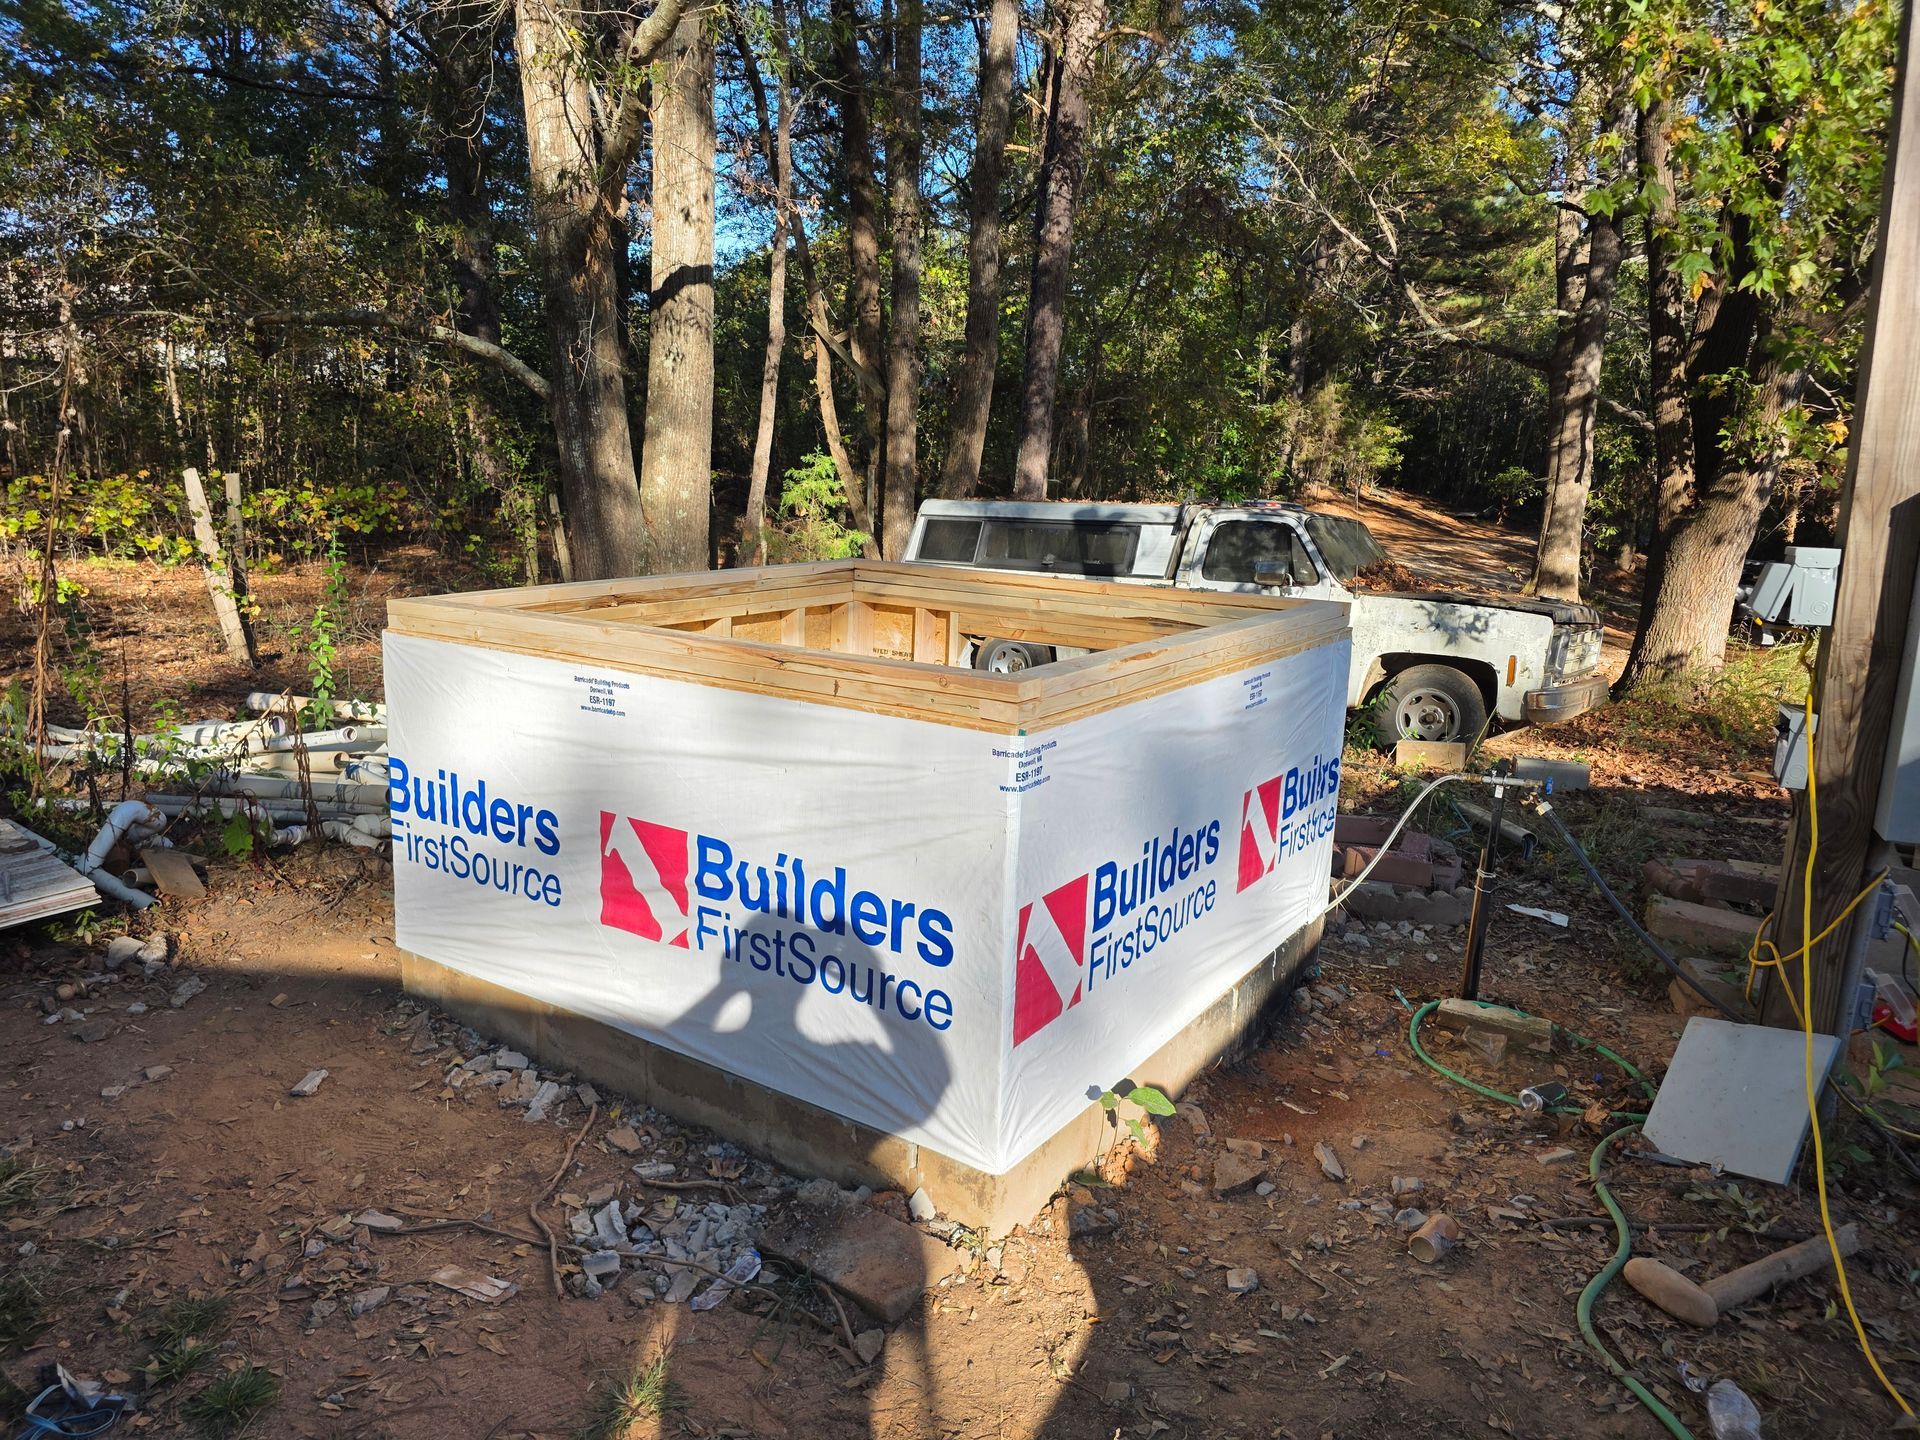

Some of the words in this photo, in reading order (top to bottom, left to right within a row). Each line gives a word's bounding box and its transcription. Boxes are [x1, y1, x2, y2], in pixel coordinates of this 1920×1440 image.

[589, 695, 615, 706] ESR-1197
[594, 679, 611, 688] Building
[611, 680, 630, 688] Products
[388, 756, 561, 856] Builders
[1015, 765, 1043, 782] ESR-1197
[694, 834, 954, 968] Builders
[1092, 819, 1220, 934] Builders
[695, 905, 953, 1031] FirstSource
[1088, 879, 1216, 993] FirstSource
